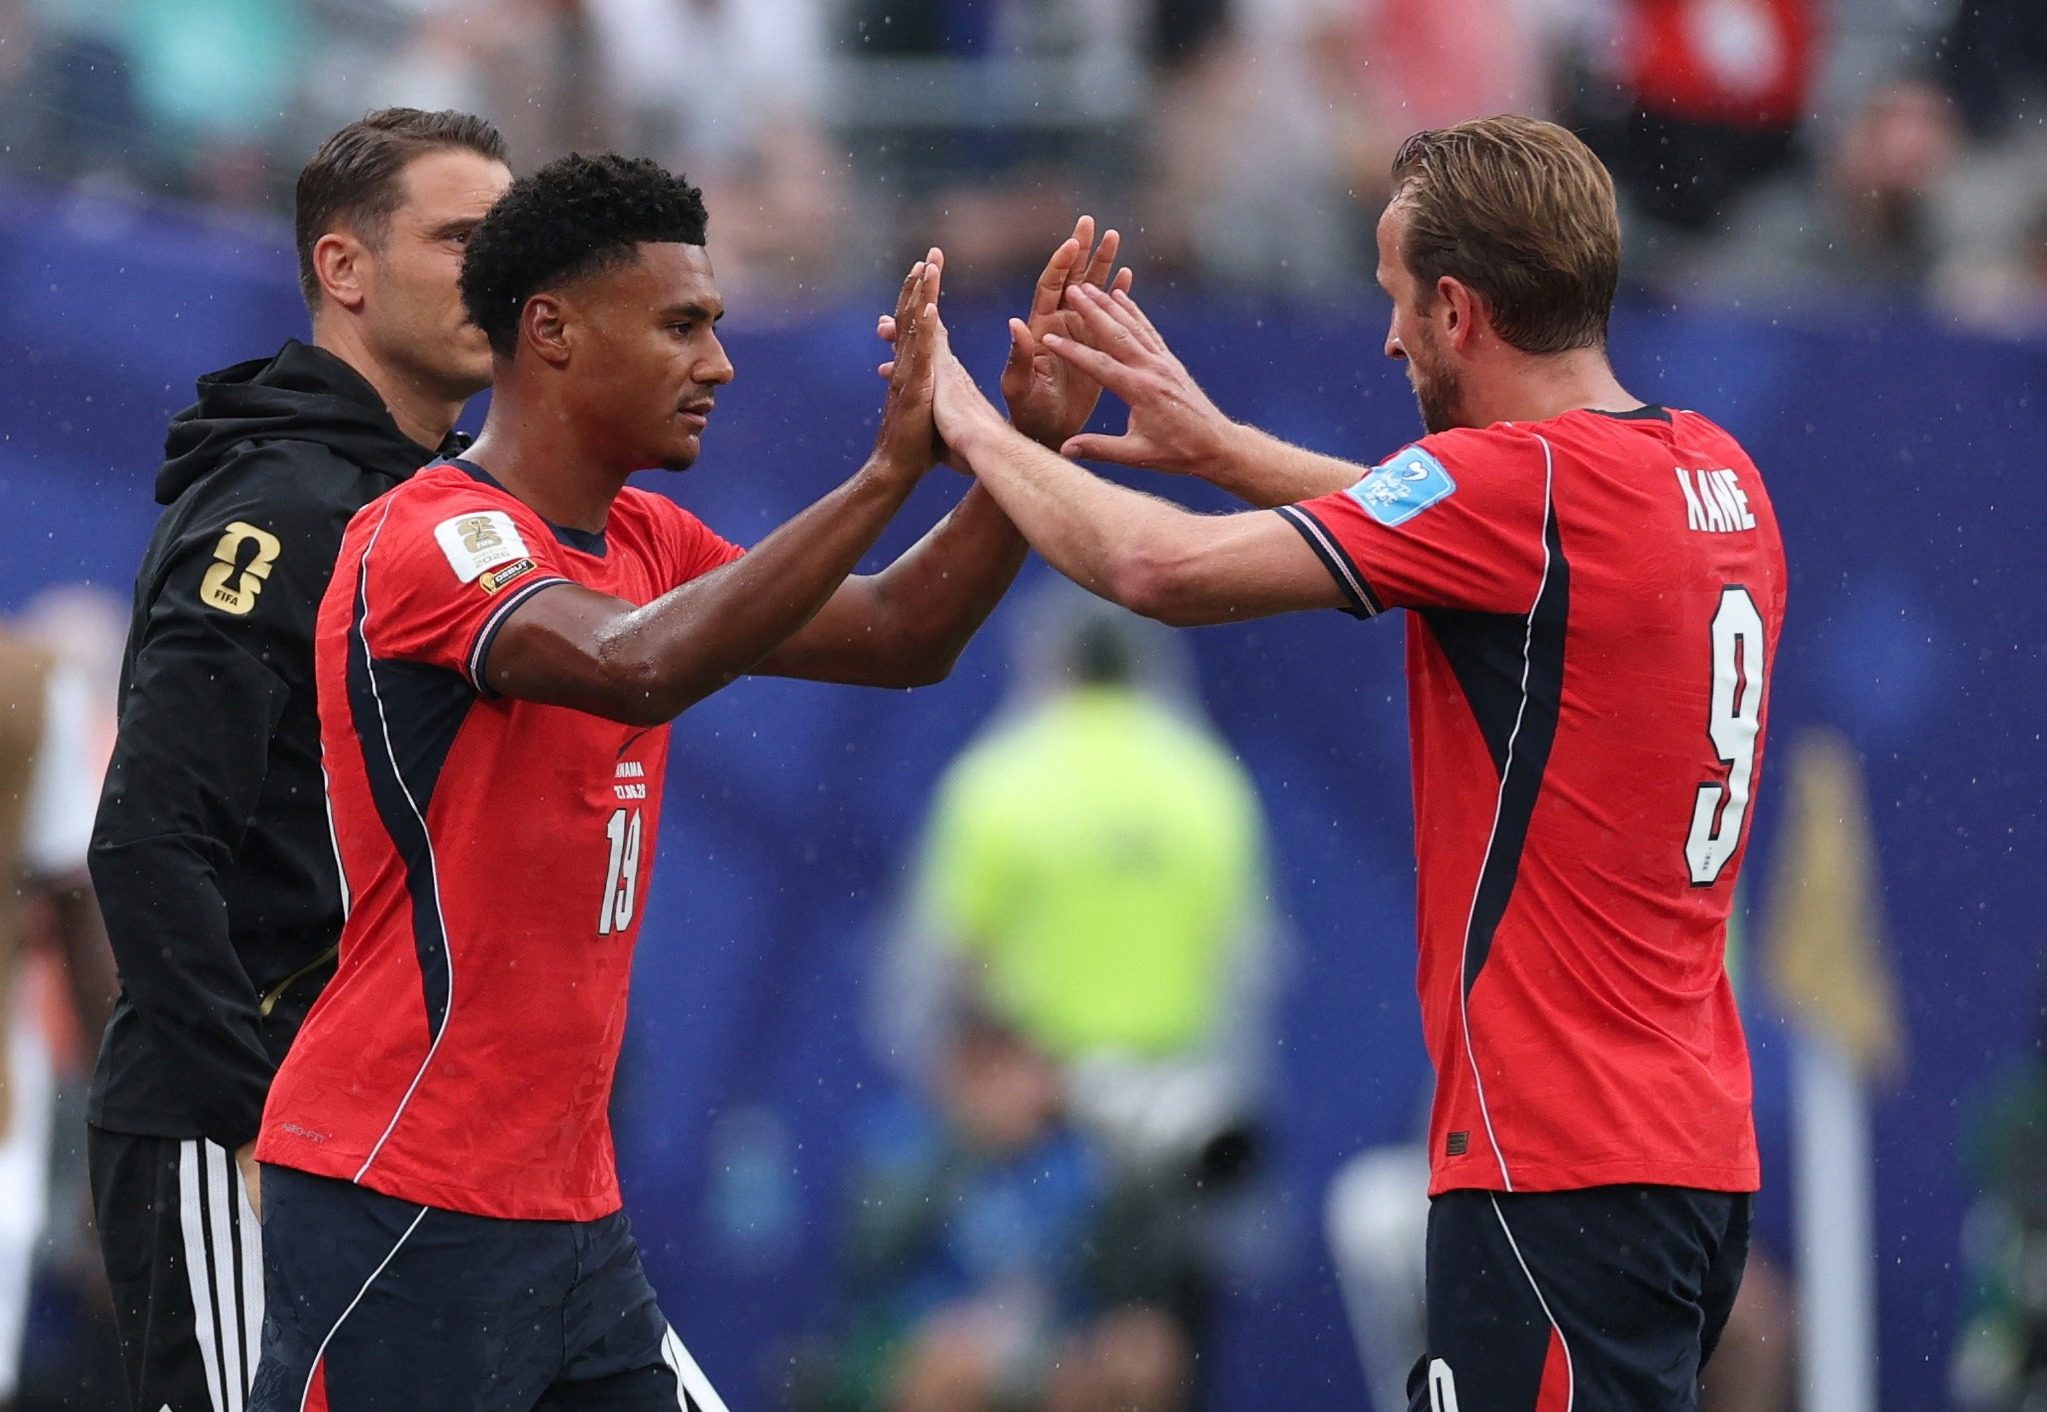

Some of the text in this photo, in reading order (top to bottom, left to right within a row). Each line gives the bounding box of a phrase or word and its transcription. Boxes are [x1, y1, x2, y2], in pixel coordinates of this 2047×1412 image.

[1674, 466, 1757, 533] KANE
[214, 589, 239, 607] FIFA
[1684, 583, 1765, 888] 9
[598, 807, 641, 936] 19
